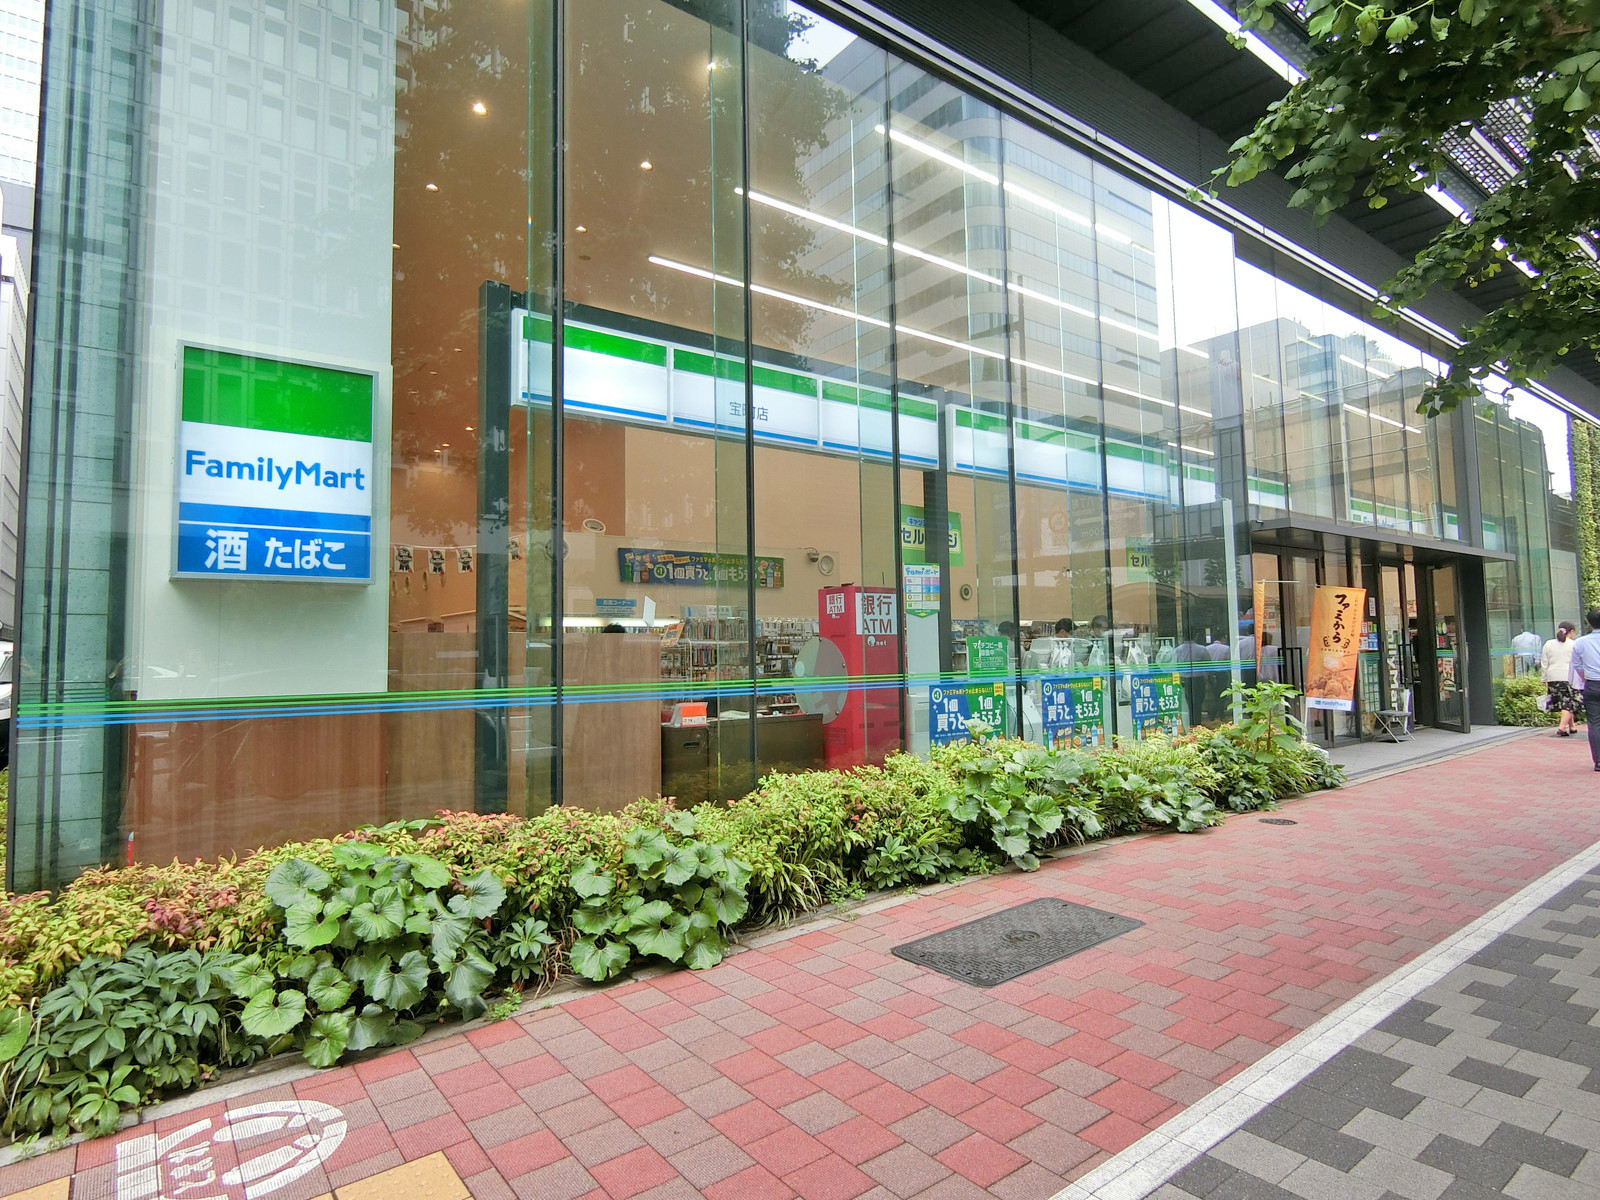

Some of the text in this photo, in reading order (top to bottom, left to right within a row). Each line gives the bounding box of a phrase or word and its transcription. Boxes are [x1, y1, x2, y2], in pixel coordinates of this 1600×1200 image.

[185, 449, 365, 490] FamilyMart
[204, 528, 346, 571] 酒 たばこ
[828, 594, 842, 605] 銀行
[861, 595, 892, 616] 銀行
[829, 605, 843, 613] ATM
[863, 619, 892, 633] ATM
[1332, 593, 1351, 644] ファミから
[978, 695, 993, 710] 1個
[1052, 690, 1065, 704] 1個
[1080, 689, 1093, 702] 1個
[1158, 695, 1179, 711] もらえる
[943, 697, 958, 712] 1個
[1075, 701, 1100, 718] もらえる
